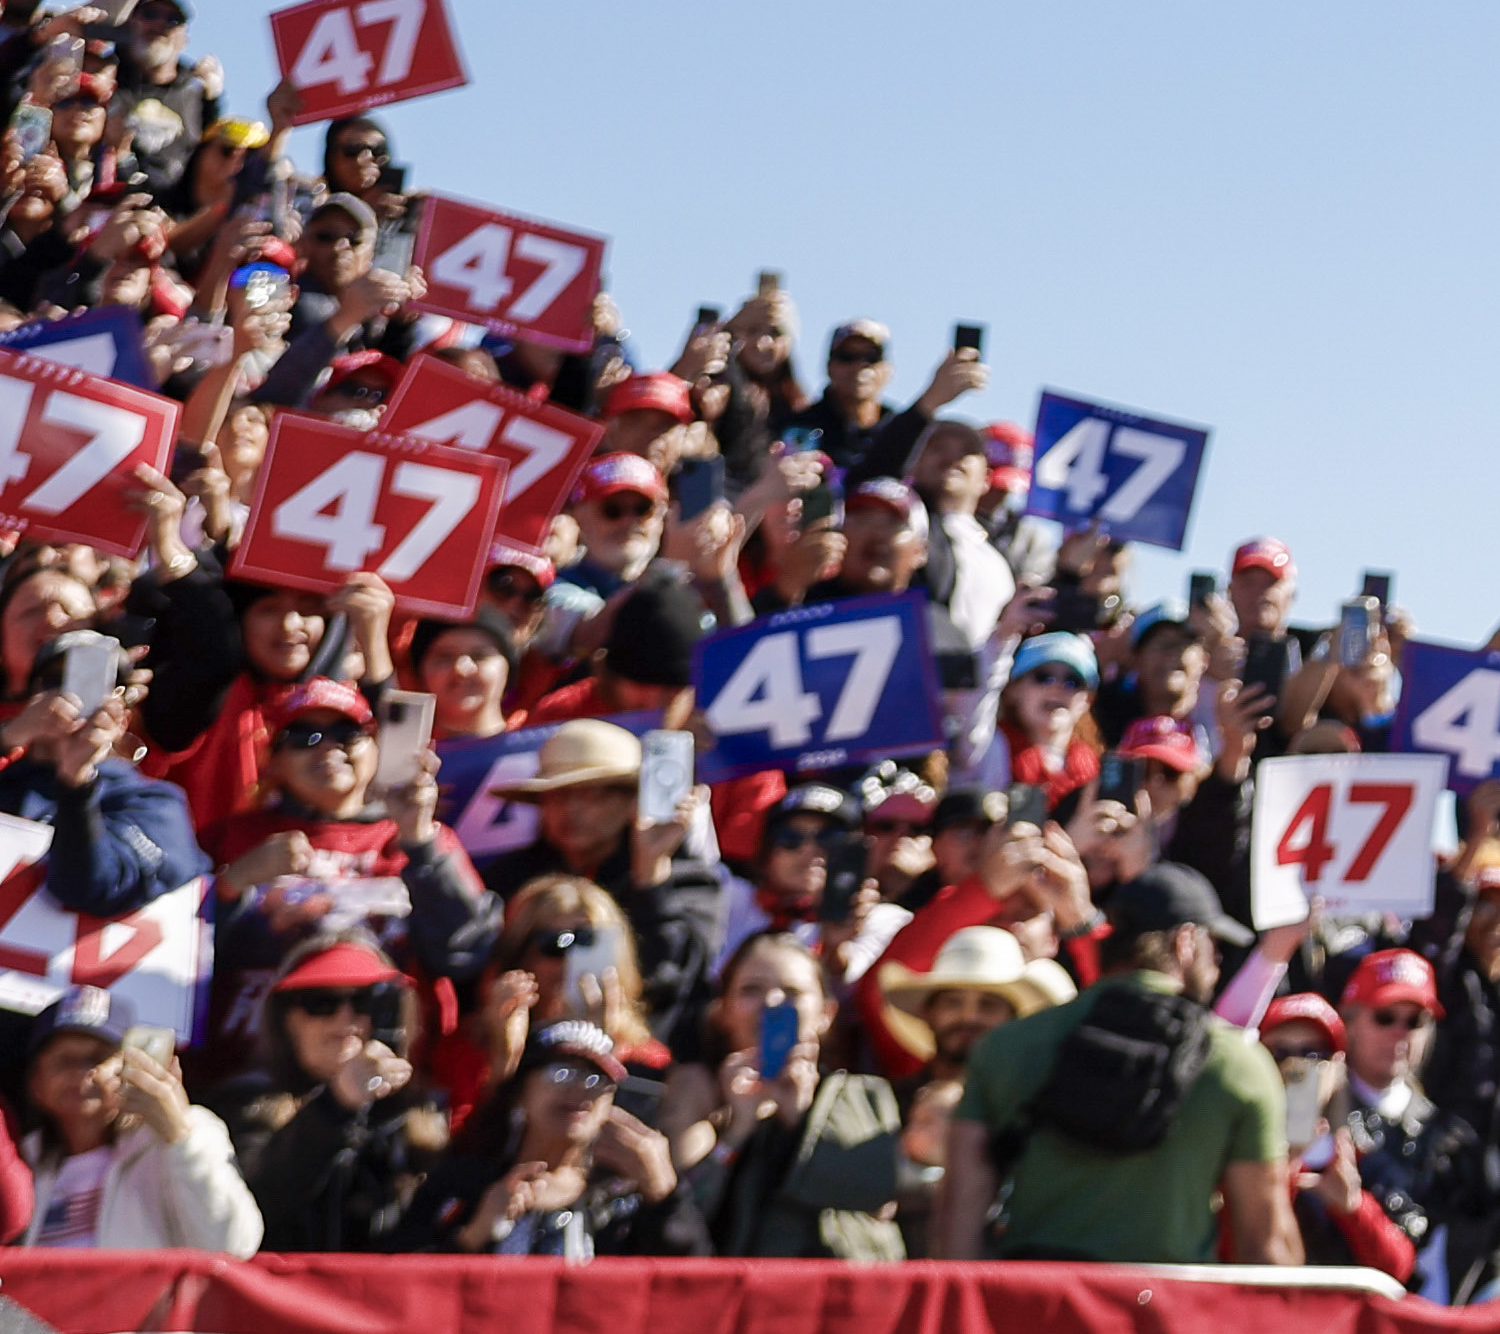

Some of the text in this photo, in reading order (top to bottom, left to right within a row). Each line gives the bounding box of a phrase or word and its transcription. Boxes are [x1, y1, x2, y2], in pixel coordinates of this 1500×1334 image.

[431, 223, 588, 322] 47
[272, 451, 483, 581] 47
[1034, 416, 1189, 524] 47
[706, 616, 903, 749] 47
[455, 750, 541, 854] 4
[1275, 783, 1416, 884] 47
